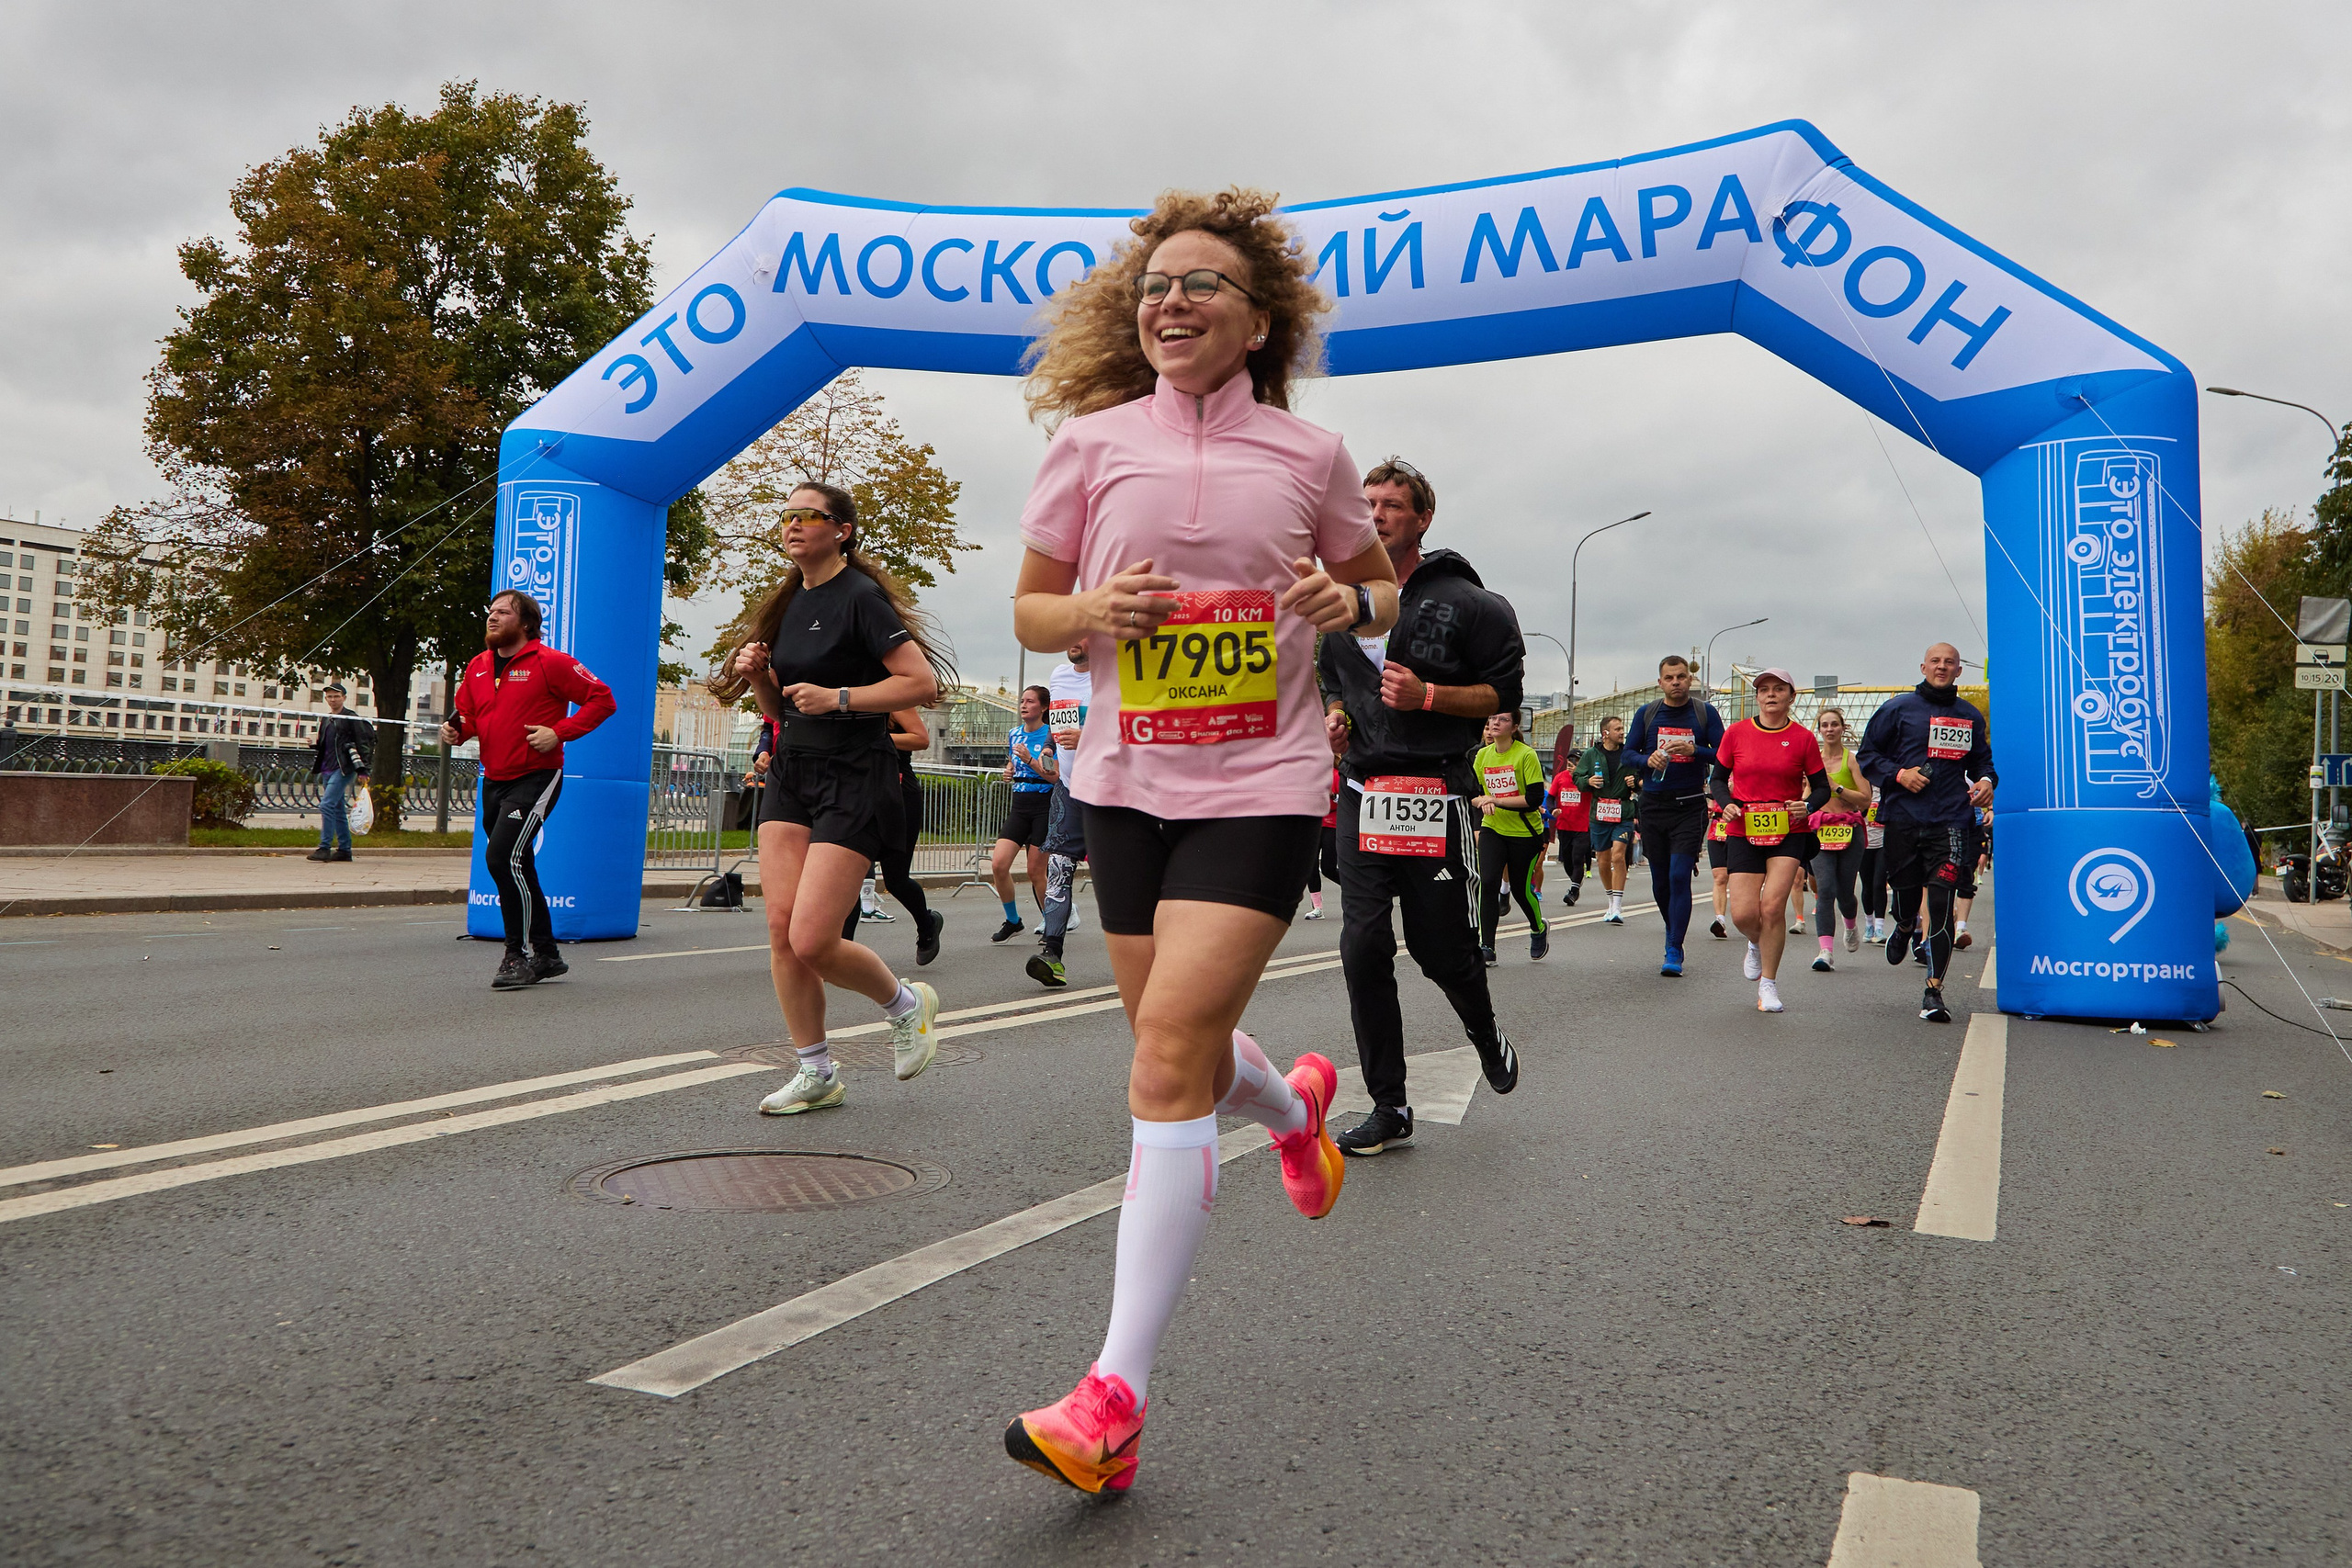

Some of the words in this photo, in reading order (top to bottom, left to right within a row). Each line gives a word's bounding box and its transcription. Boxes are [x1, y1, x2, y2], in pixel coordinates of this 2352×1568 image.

[602, 283, 746, 414] ЭТО
[772, 209, 1425, 305] МОСКОИЙ
[1460, 173, 2013, 372] МАРАФОН
[2109, 475, 2141, 539] Это
[535, 511, 561, 563] Это
[1214, 608, 1232, 623] 10
[1125, 630, 1272, 682] 17905
[2109, 550, 2151, 758] электробус
[2312, 674, 2321, 682] 15
[2324, 673, 2339, 683] 20
[1169, 684, 1228, 699] ОКСАНА
[1050, 709, 1079, 725] 24033
[1132, 716, 1153, 742] G
[1932, 727, 1971, 743] 15293
[1485, 776, 1516, 789] 26354
[1414, 786, 1424, 795] 10
[1365, 795, 1444, 822] 11532
[1598, 806, 1621, 815] 26730
[1753, 814, 1778, 827] 531
[1819, 827, 1851, 837] 14939
[1366, 837, 1377, 851] G
[1749, 837, 1755, 845] G
[2030, 954, 2195, 983] Мосгортранс
